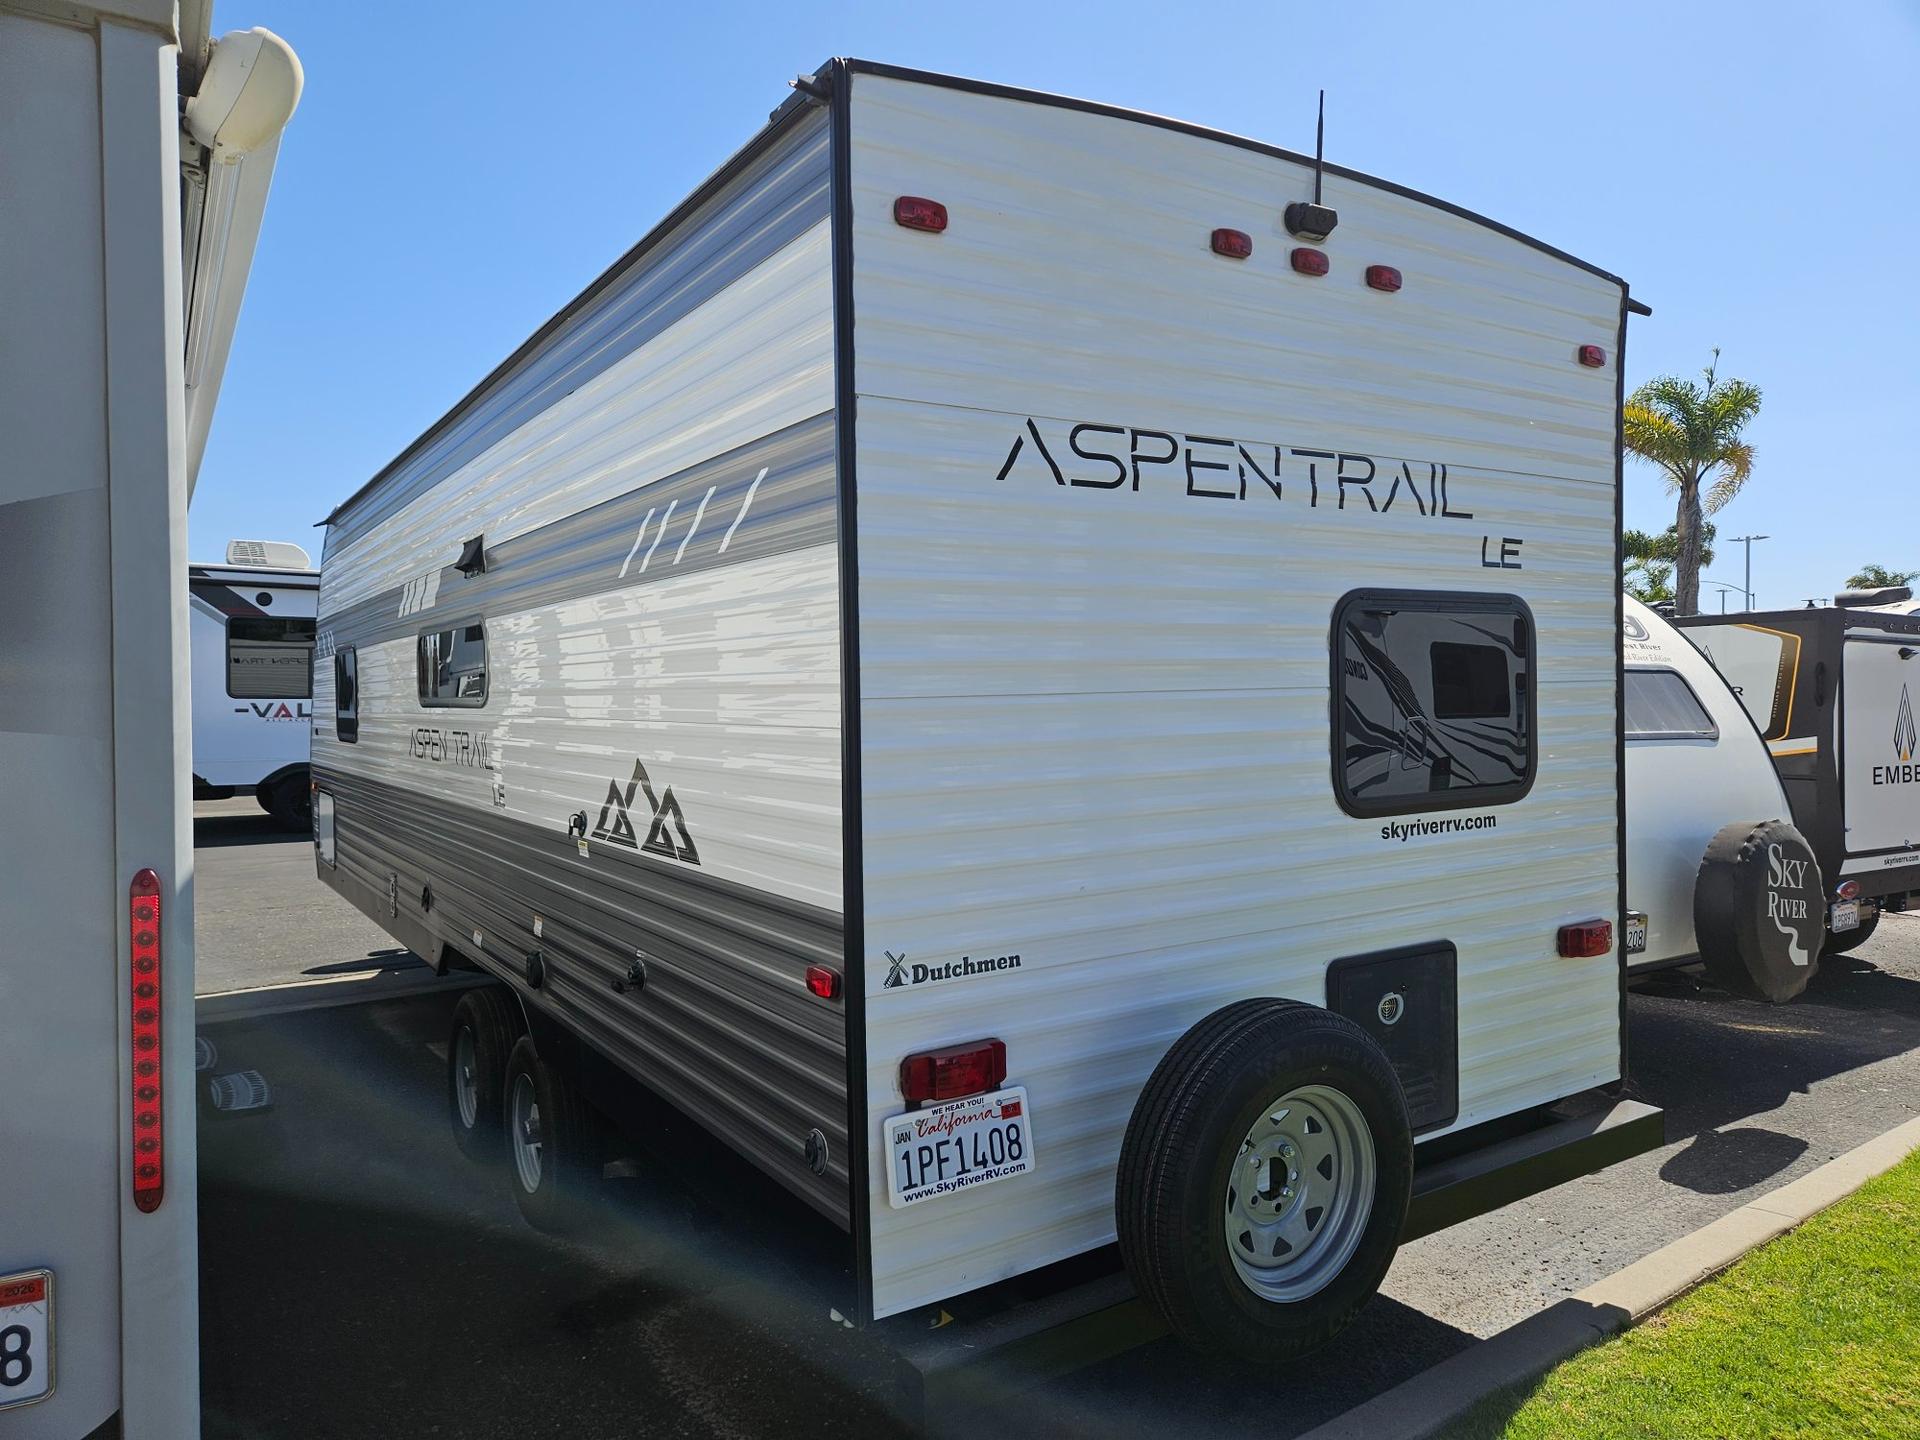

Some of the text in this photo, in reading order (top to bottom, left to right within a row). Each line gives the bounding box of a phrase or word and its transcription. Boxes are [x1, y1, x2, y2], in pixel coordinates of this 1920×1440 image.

[1481, 535, 1523, 569] LE
[409, 728, 494, 770] ASPEN TRAIL
[492, 783, 506, 808] LE
[1381, 814, 1497, 842] skyriverrv.com
[911, 954, 1022, 984] Dutchmen
[931, 1097, 984, 1116] WE HEAR YOU!
[895, 1108, 1002, 1145] JAN California
[901, 1123, 1023, 1191] 1PF1408
[903, 1162, 1026, 1202] www.SkyRiverRV.com
